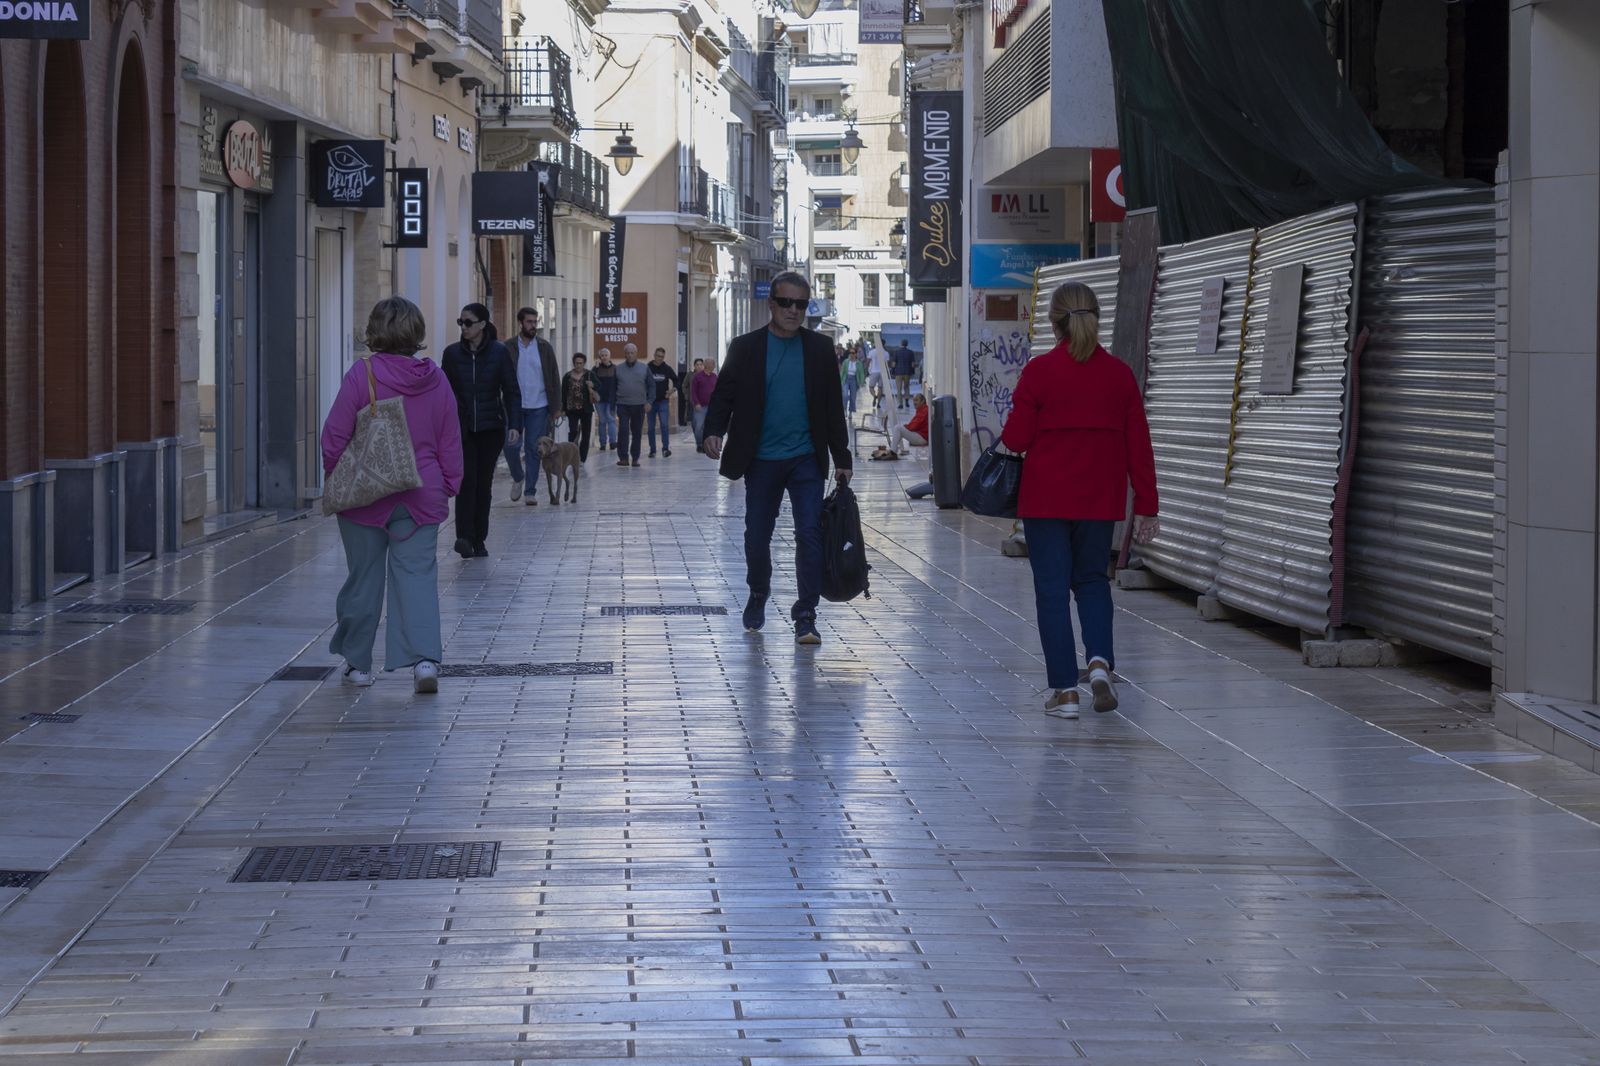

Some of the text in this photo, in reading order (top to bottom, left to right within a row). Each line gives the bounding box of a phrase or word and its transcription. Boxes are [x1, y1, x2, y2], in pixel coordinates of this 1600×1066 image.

[0, 1, 78, 21] DONIA
[861, 33, 876, 41] 671
[924, 110, 950, 199] MOMENTO
[327, 166, 376, 190] BRUTAL
[333, 188, 363, 200] ZAPAS
[992, 193, 1050, 213] MLL
[478, 217, 536, 230] TEZENIS
[608, 223, 616, 254] VIAJES
[920, 201, 950, 267] Dulce
[533, 246, 543, 273] LYNCIS
[843, 250, 878, 260] RURAL
[595, 326, 637, 335] CANAGLIA BAR
